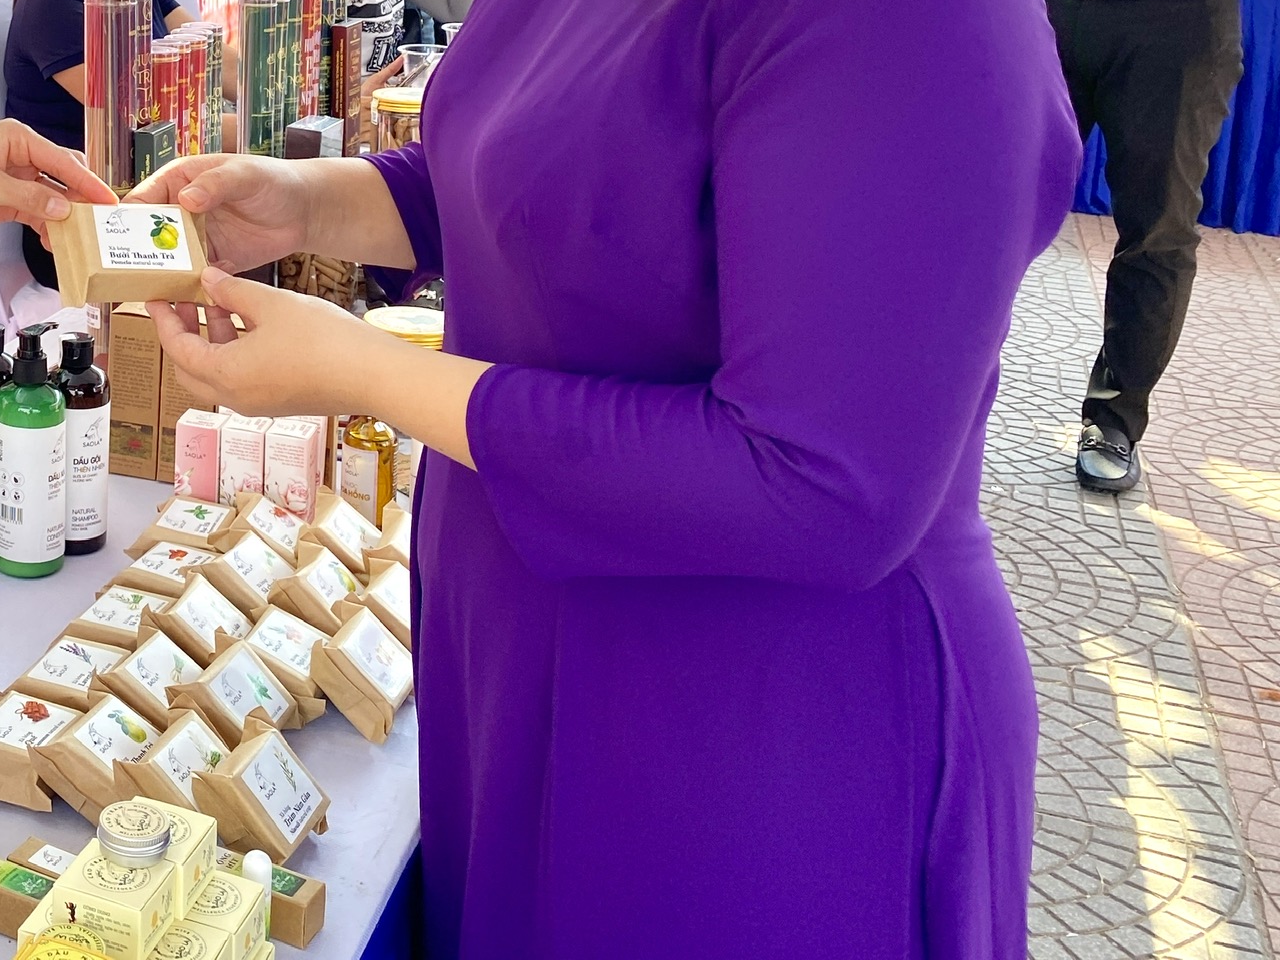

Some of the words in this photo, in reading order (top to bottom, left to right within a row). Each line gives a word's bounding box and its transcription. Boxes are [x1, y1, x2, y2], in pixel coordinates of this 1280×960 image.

[110, 251, 130, 259] Bưởi
[133, 252, 158, 260] Thanh
[160, 252, 175, 260] Trà
[83, 440, 100, 448] SAOLA
[185, 452, 203, 460] SAOLA
[147, 673, 159, 687] SAOLA
[230, 692, 242, 706] SAOLA
[0, 726, 13, 739] SAOLA
[100, 738, 113, 754] SAOLA
[178, 767, 191, 783] SAOLA
[265, 783, 277, 800] SAOLA
